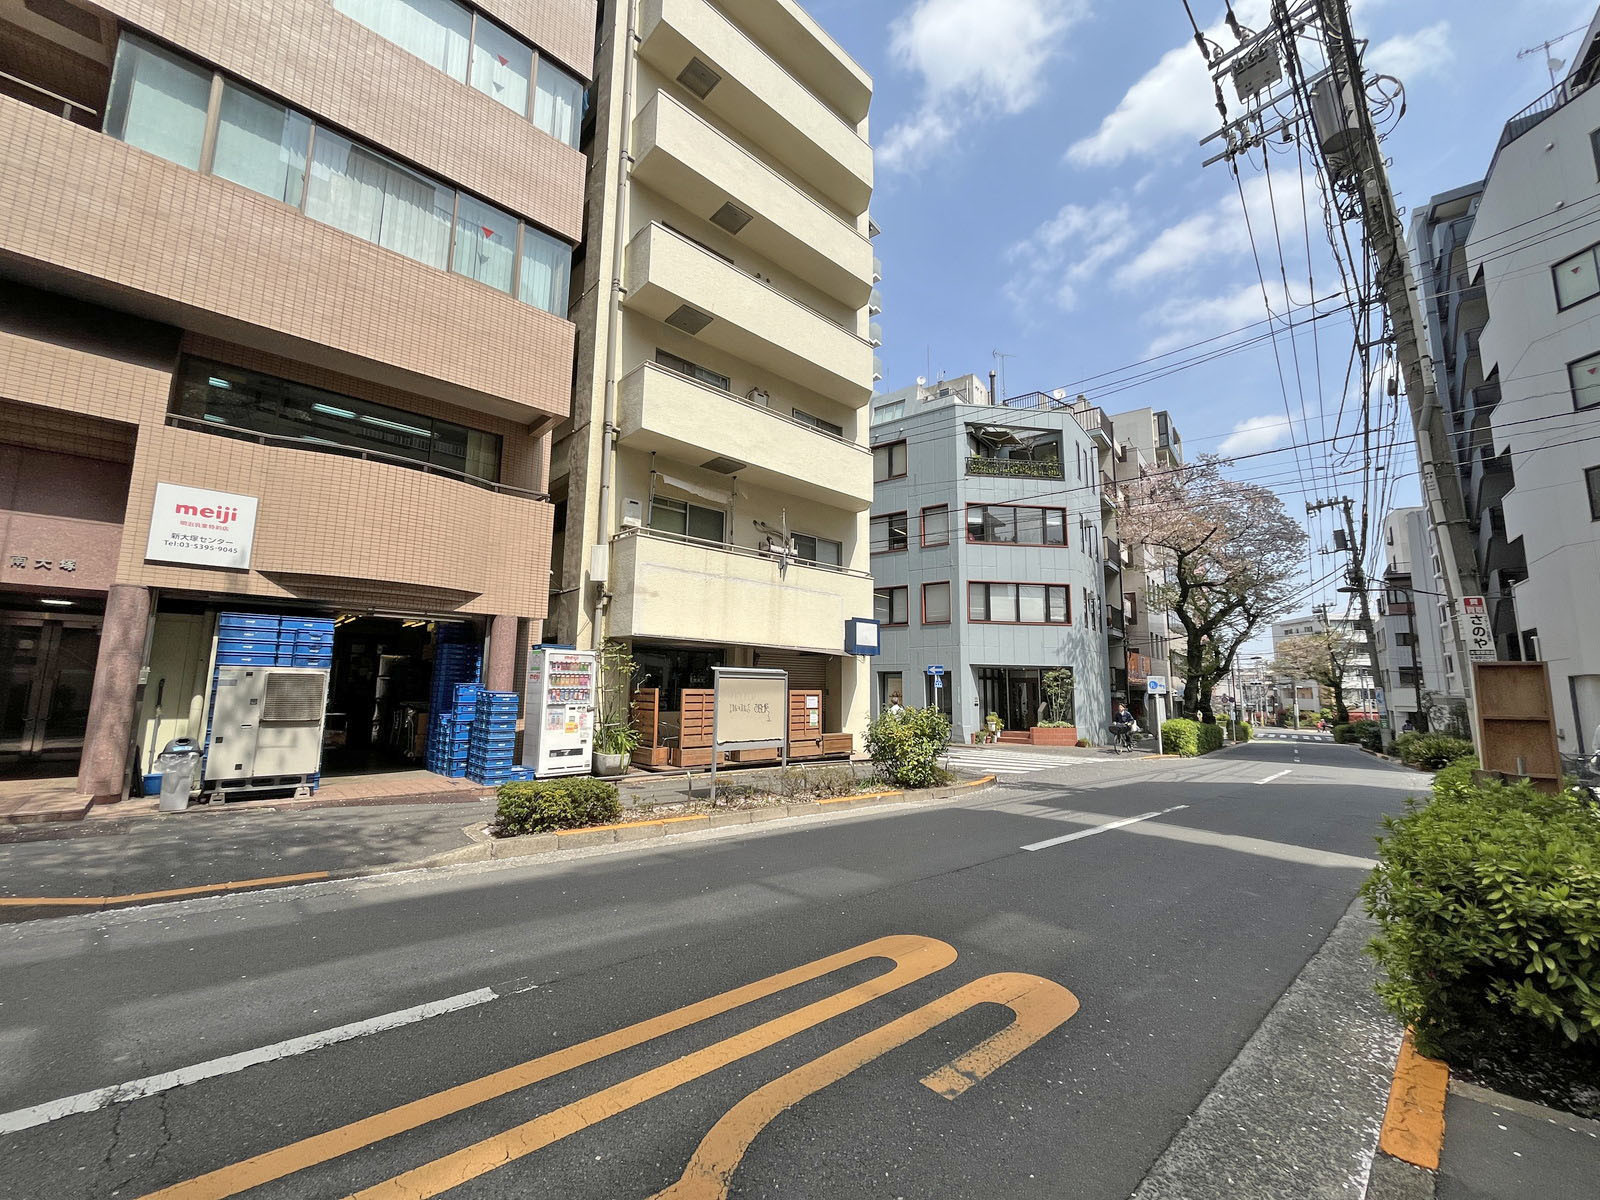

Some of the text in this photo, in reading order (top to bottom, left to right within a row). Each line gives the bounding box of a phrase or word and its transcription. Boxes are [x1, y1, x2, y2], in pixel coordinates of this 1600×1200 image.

[175, 503, 238, 524] meiji
[171, 532, 234, 545] 新大塚センター
[1470, 615, 1488, 648] さのや
